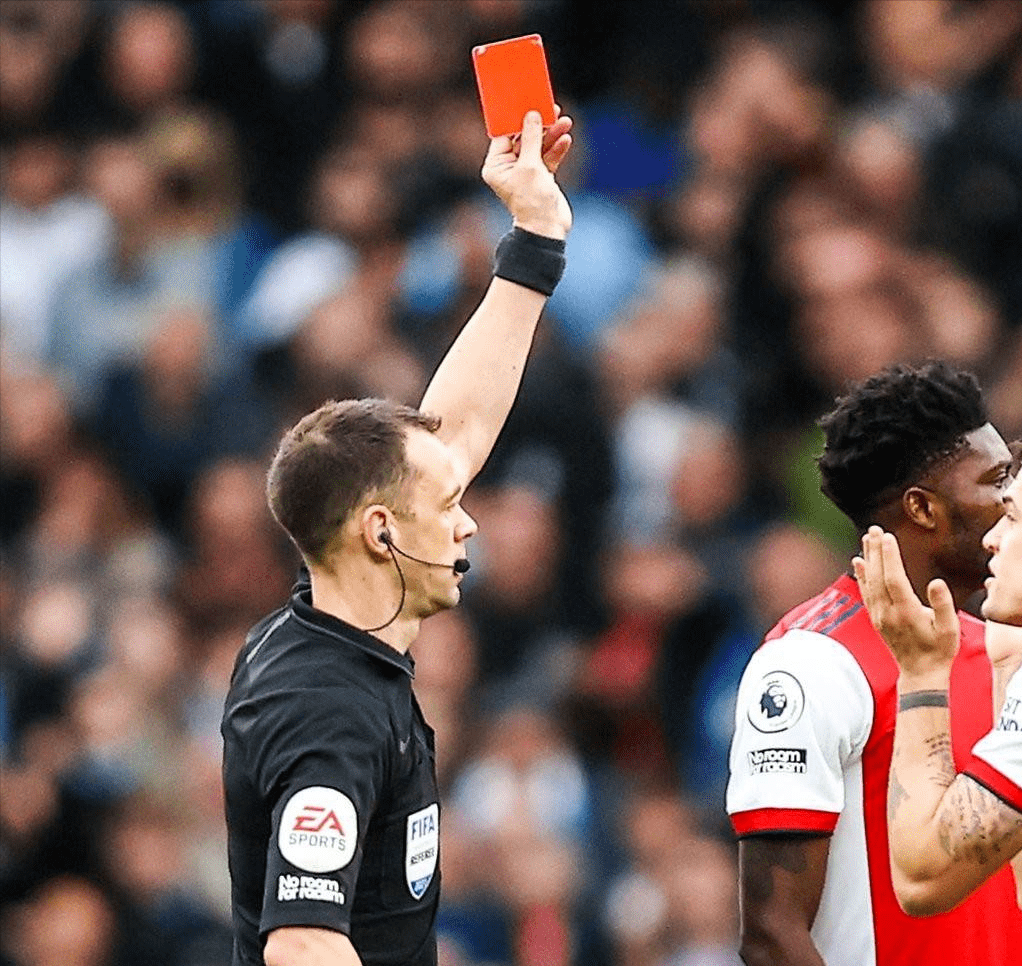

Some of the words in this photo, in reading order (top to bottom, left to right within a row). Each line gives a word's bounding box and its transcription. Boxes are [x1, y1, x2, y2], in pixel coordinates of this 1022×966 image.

[763, 750, 800, 762] room
[292, 806, 346, 837] EA
[411, 814, 435, 841] FIFA
[288, 833, 347, 851] SPORTS
[278, 874, 300, 889] No
[300, 875, 339, 892] room
